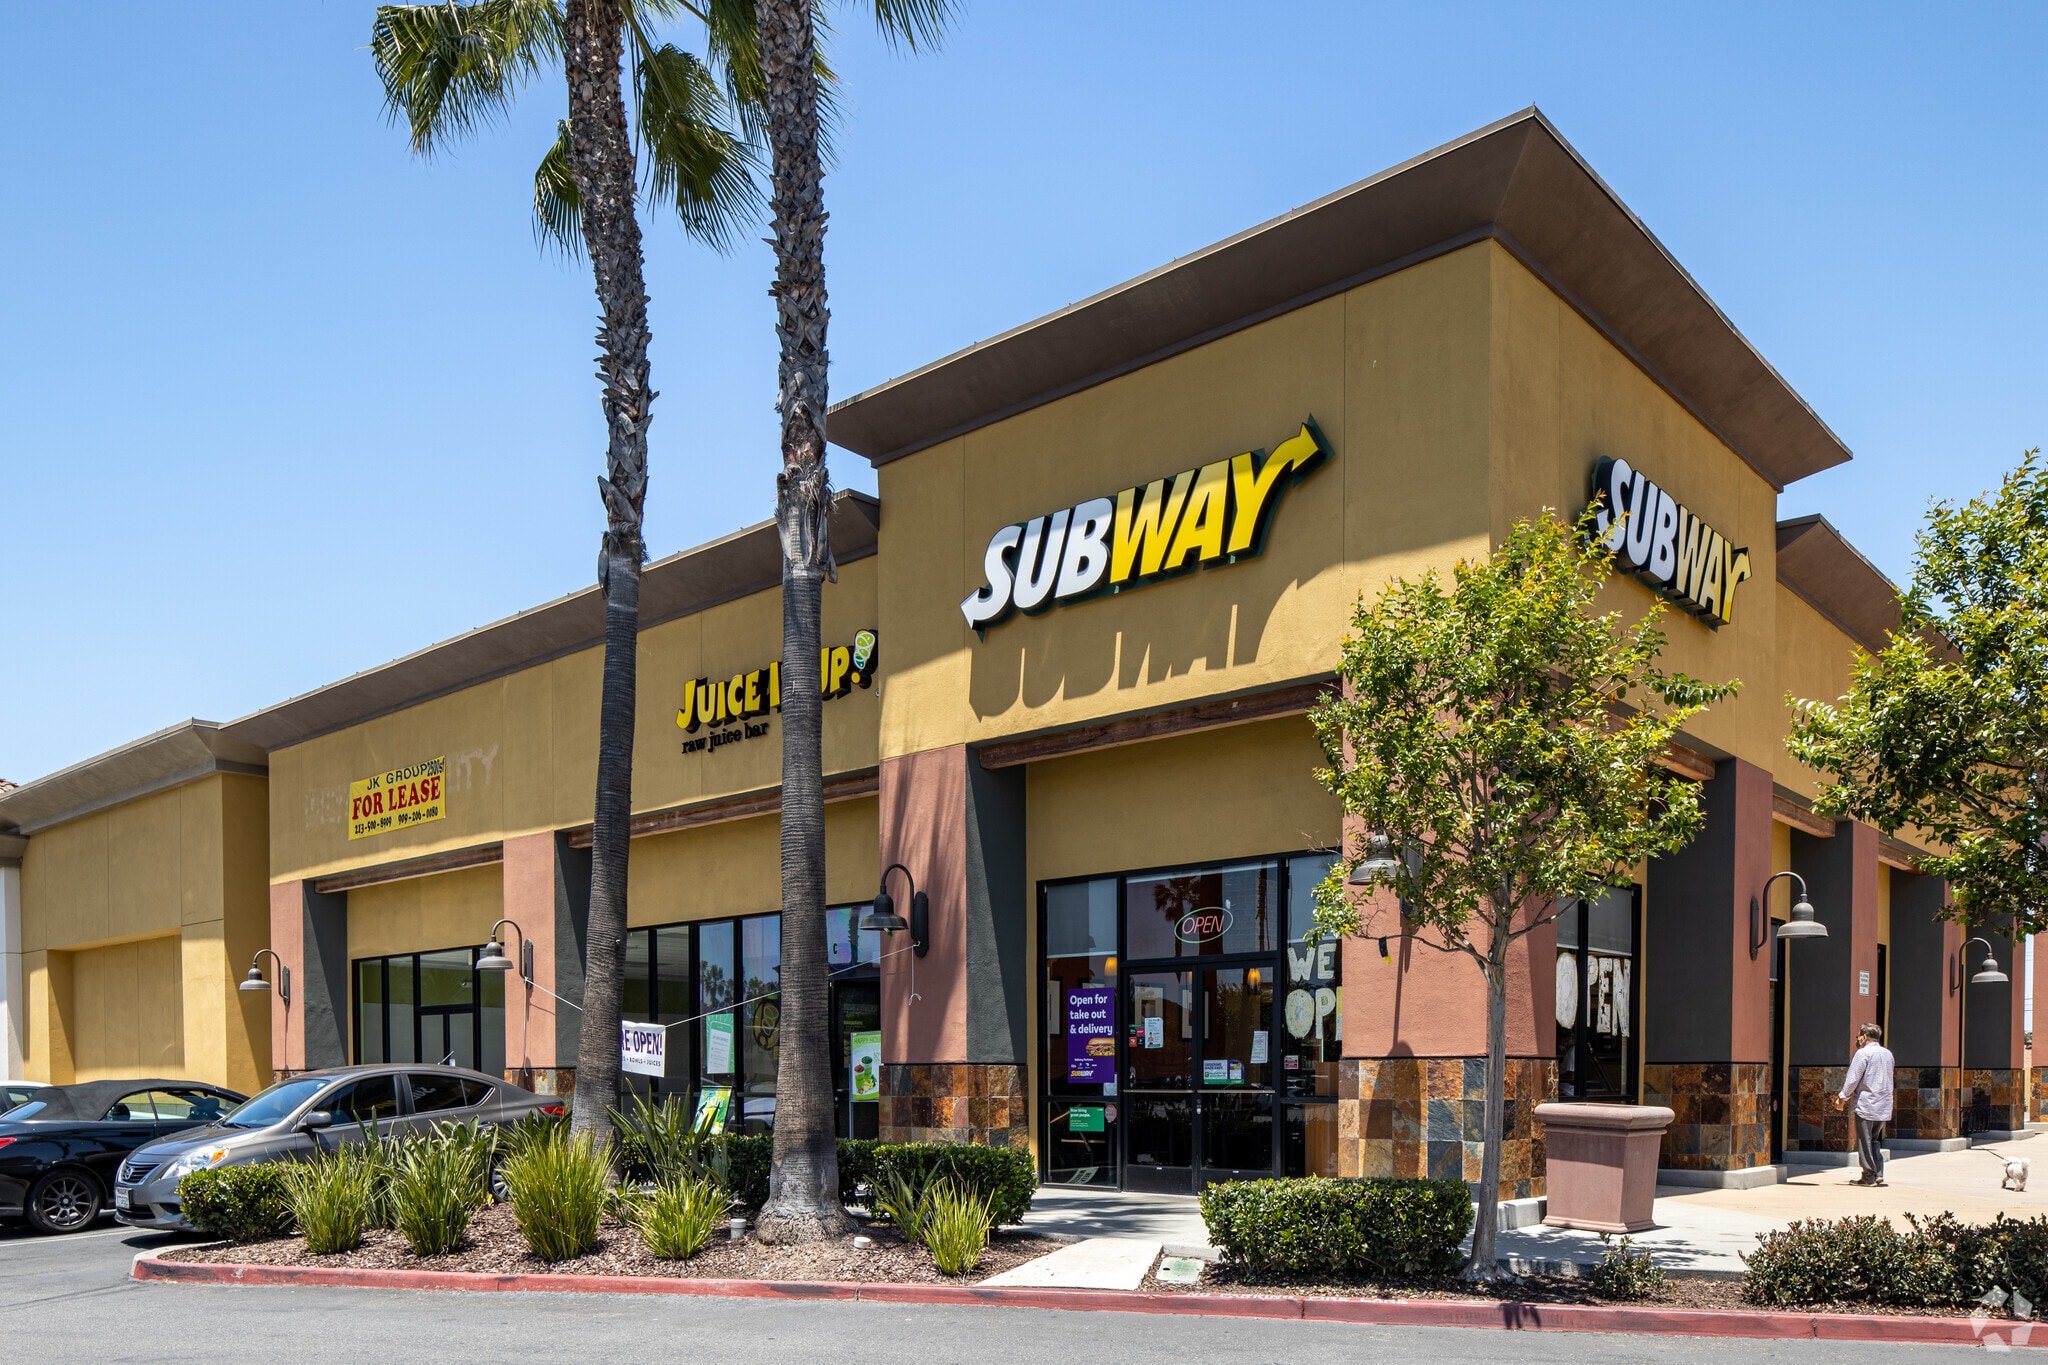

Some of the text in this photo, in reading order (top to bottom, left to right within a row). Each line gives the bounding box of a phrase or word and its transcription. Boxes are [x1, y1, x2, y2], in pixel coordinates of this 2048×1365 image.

[960, 422, 1320, 630] SUBWAY
[1596, 458, 1752, 625] SUBWAY
[676, 669, 762, 729] JUICE
[682, 722, 769, 754] raw juice bar
[366, 776, 380, 790] JK
[386, 763, 427, 784] GROUP
[352, 791, 384, 820] FOR
[388, 776, 440, 811] LEASE
[1182, 915, 1225, 934] OPEN
[1287, 943, 1337, 982] WE
[1070, 994, 1108, 1007] Open for
[1556, 952, 1631, 1037] OPEN
[1070, 1009, 1106, 1019] take out
[1070, 1023, 1113, 1035] & delivery
[1285, 986, 1342, 1039] OP
[633, 1031, 662, 1056] OPEN!
